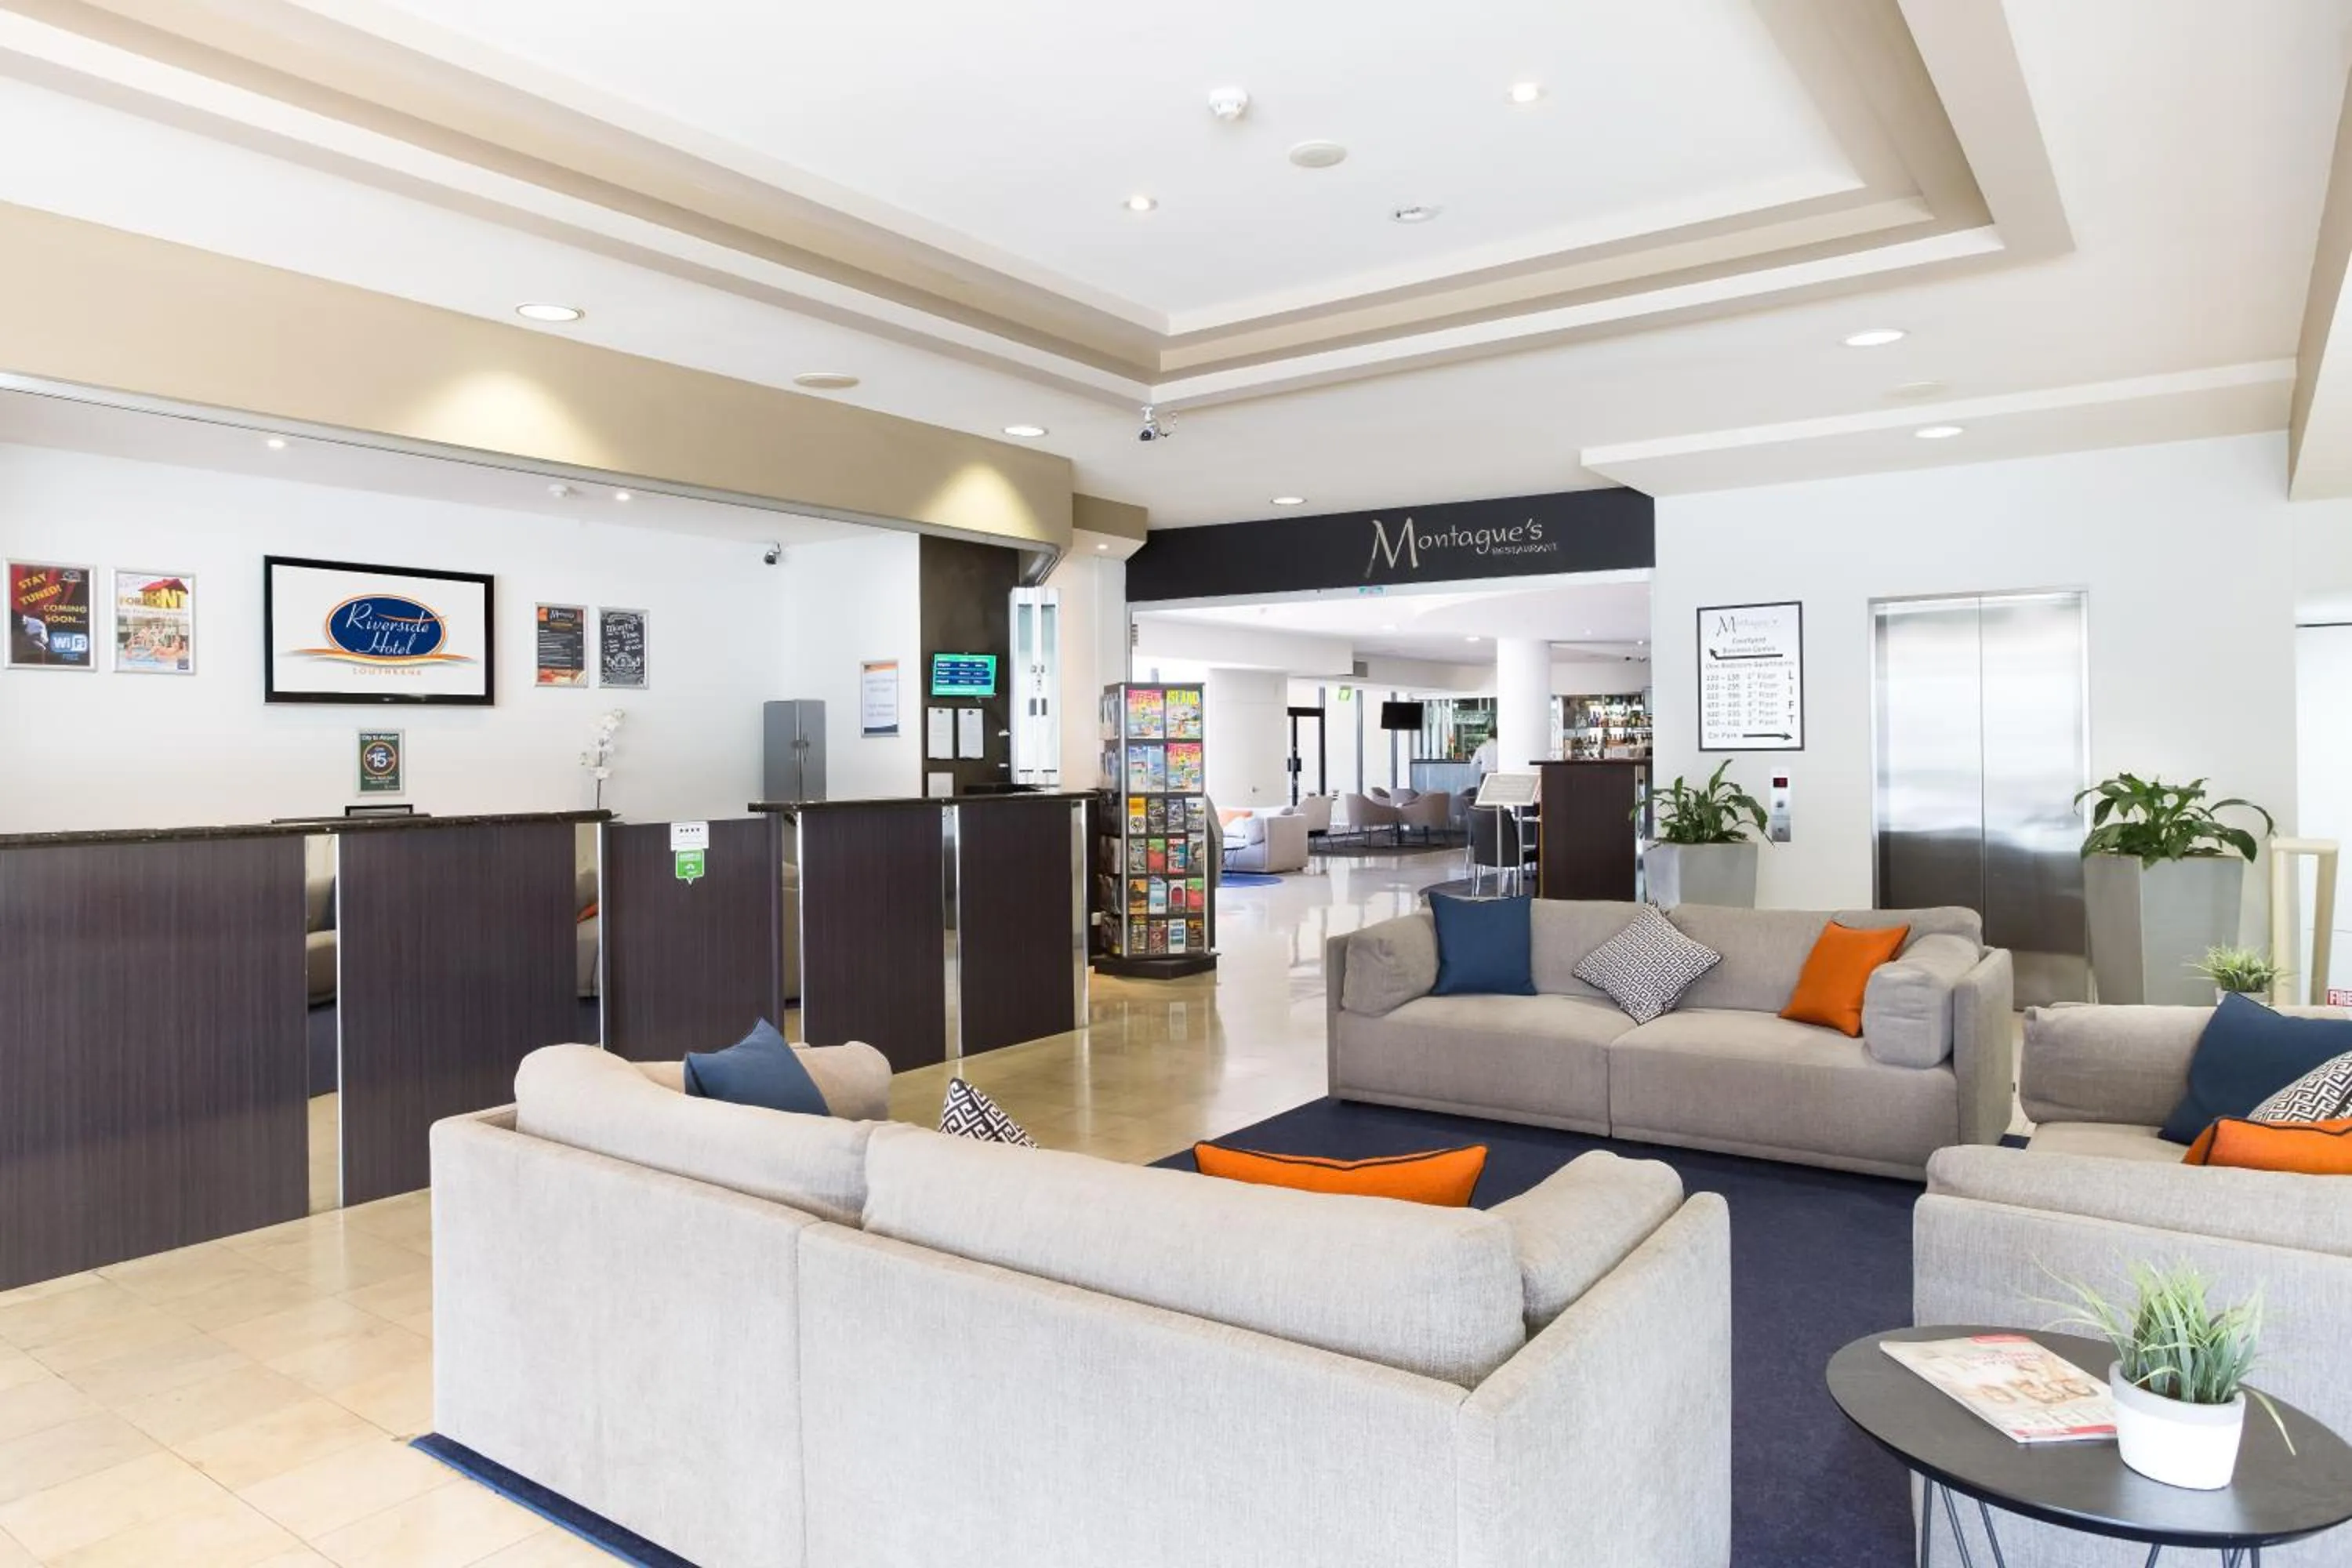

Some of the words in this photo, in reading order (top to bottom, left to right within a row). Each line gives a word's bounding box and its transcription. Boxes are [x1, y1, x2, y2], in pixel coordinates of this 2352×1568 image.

[1365, 516, 1543, 579] Montague's
[18, 573, 47, 590] STAY
[19, 584, 62, 606] TUNED!
[345, 602, 430, 633] Riverside
[355, 631, 416, 655] Hotel
